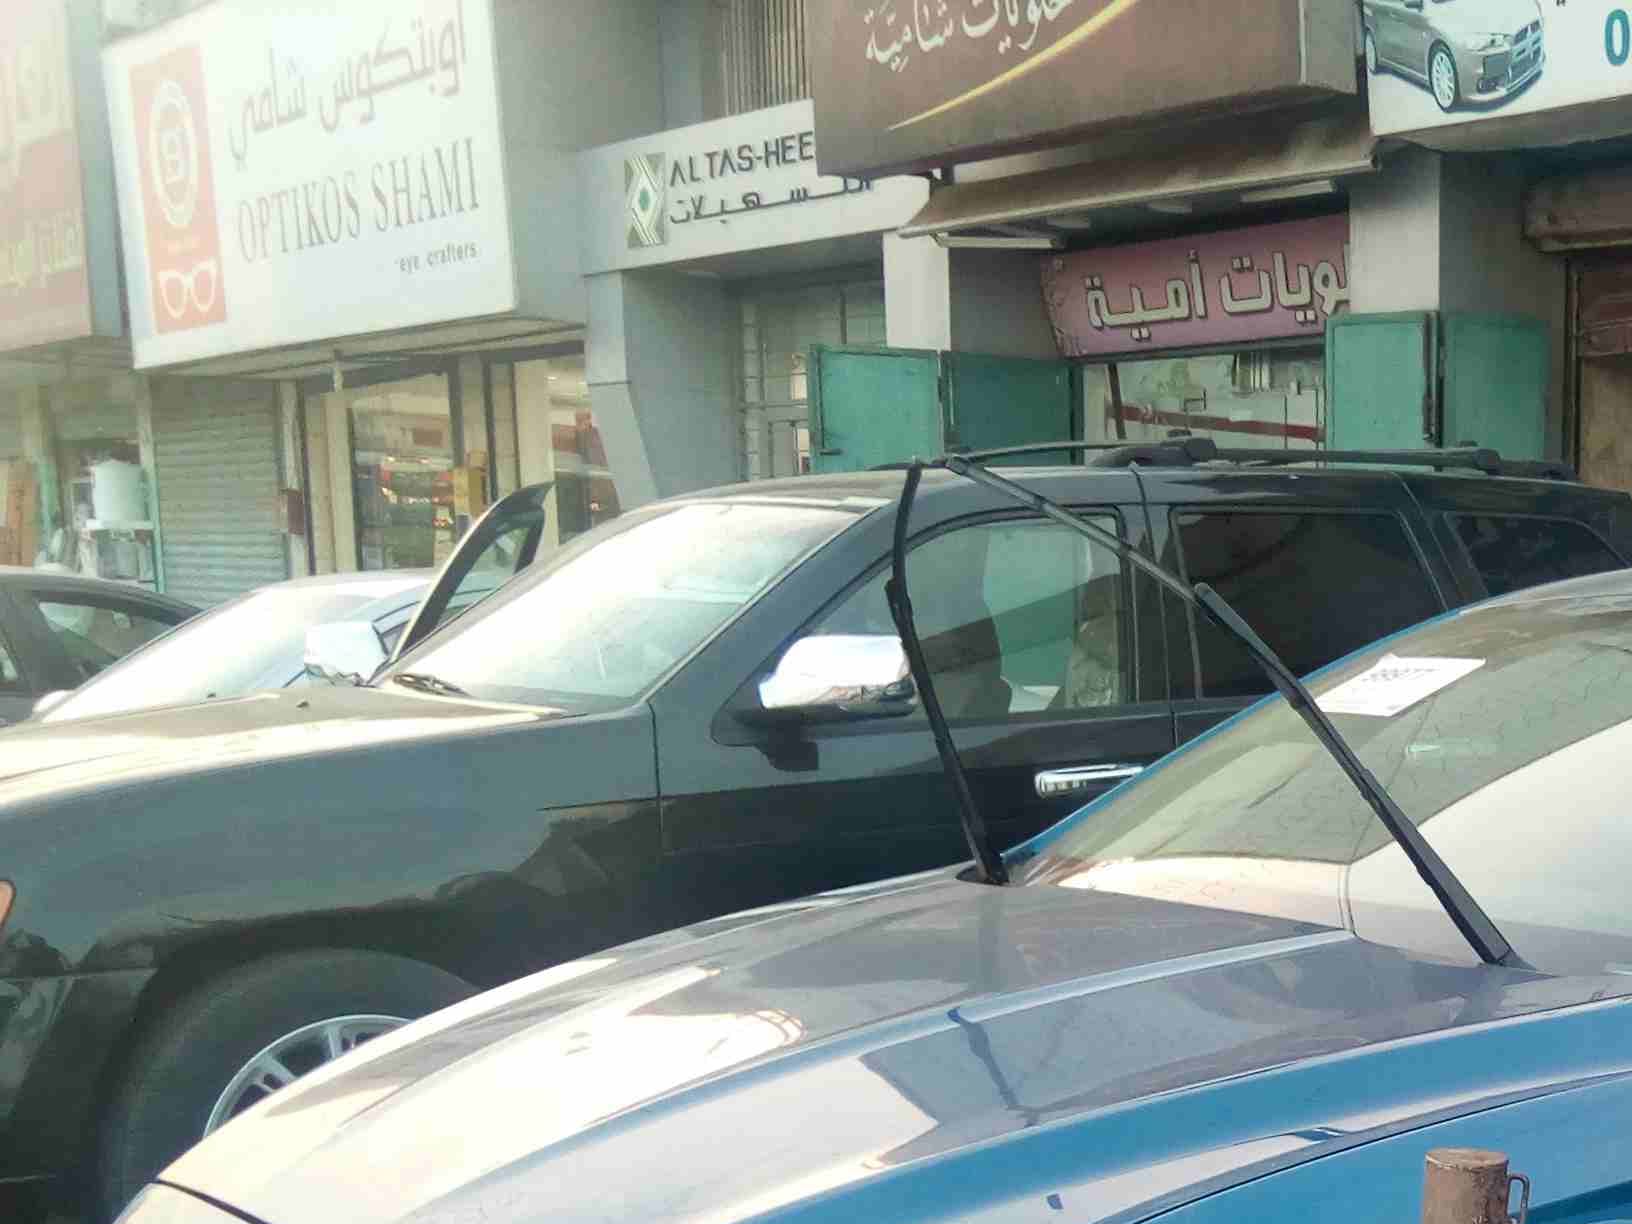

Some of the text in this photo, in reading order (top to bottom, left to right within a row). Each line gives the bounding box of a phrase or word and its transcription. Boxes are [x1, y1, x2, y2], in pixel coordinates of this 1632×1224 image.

[228, 47, 307, 172] شامي
[238, 137, 479, 263] OPTIKOS SHAMI
[399, 242, 477, 274] eye crafters
[1085, 250, 1206, 341] أمية
